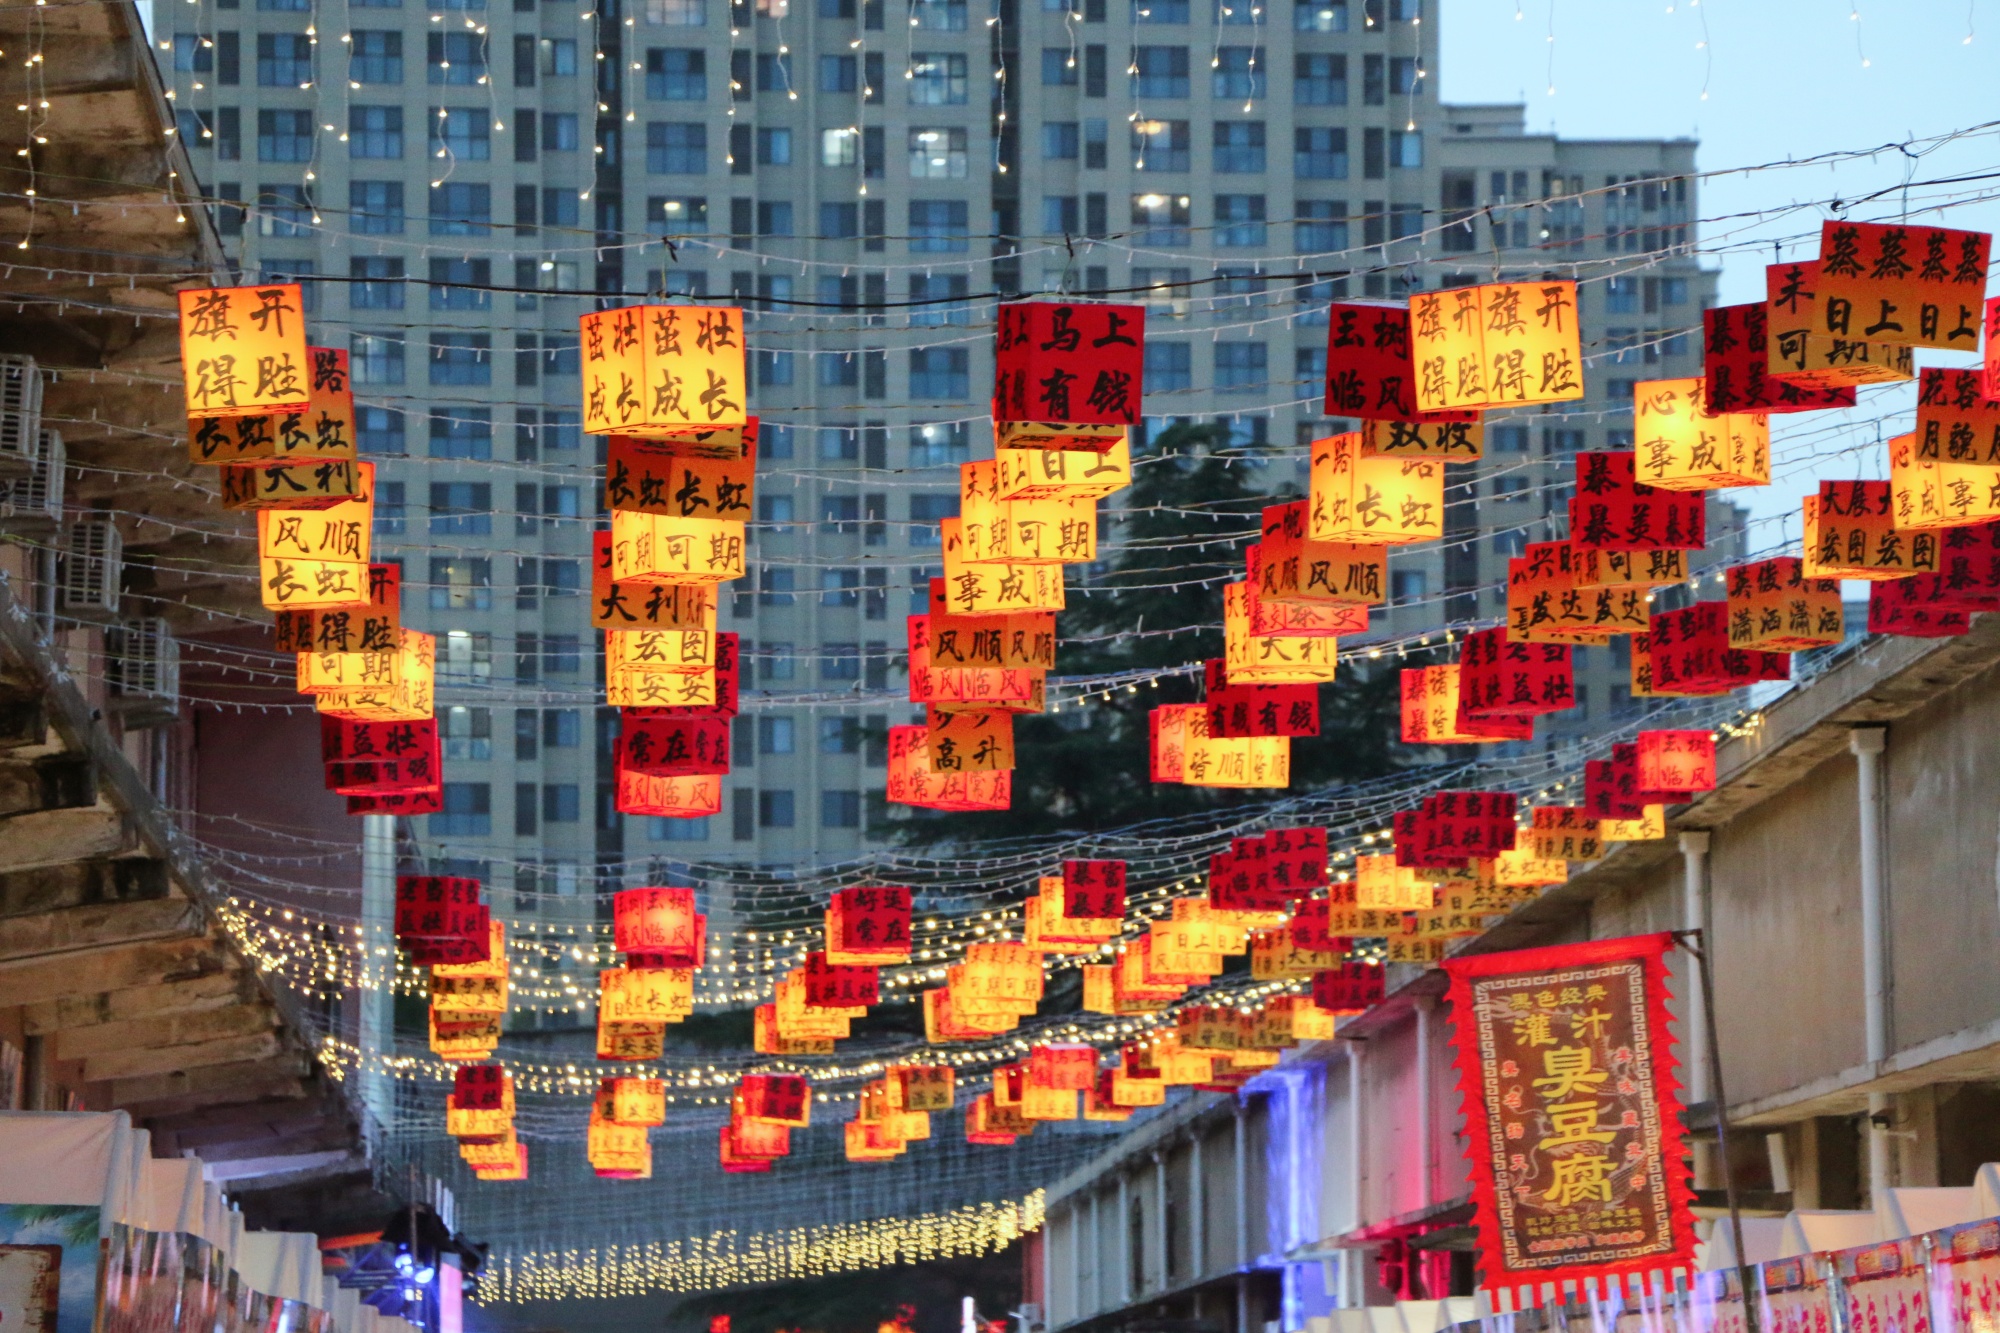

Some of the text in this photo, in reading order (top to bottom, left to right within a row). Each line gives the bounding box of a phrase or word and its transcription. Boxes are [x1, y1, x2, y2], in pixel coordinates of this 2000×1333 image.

[1822, 226, 1913, 280] 蒸蒸
[1919, 232, 1985, 285] 蒸蒸
[188, 289, 295, 342] 旗开
[1040, 307, 1137, 352] 马上
[1417, 290, 1477, 342] 旗开
[1487, 286, 1571, 338] 旗开
[1826, 296, 1904, 337] 日上
[1919, 303, 1976, 341] 日上
[587, 310, 640, 362] 茁壮
[653, 309, 737, 356] 茁壮
[1333, 310, 1410, 360] 玉树
[193, 352, 306, 407] 得胜
[1330, 369, 1410, 417] 临风
[1421, 352, 1487, 406] 得胜
[1491, 348, 1579, 400] 得胜
[1919, 371, 1982, 411] 花容
[588, 372, 641, 426] 成长
[651, 368, 741, 421] 成长
[1039, 368, 1134, 423] 有钱
[196, 417, 273, 458] 长虹
[279, 411, 348, 450] 长虹
[1920, 419, 1977, 460] 月貌
[1042, 450, 1122, 481] 日上
[1314, 437, 1352, 476] 一路
[1643, 431, 1722, 478] 事成
[1731, 432, 1768, 480] 事成
[608, 459, 667, 508] 长虹
[675, 470, 751, 517] 长虹
[1823, 481, 1871, 518] 大展
[1896, 479, 1939, 525] 事成
[1312, 492, 1352, 534] 长虹
[1356, 484, 1438, 530] 长虹
[1581, 504, 1660, 546] 暴美
[274, 517, 362, 559] 风顺
[664, 532, 742, 573] 可期
[966, 519, 1008, 558] 可期
[1017, 518, 1090, 558] 可期
[1819, 527, 1866, 565] 宏图
[1875, 529, 1935, 571] 宏图
[268, 560, 356, 602] 长虹
[1261, 556, 1300, 596] 风顺
[1307, 561, 1381, 599] 风顺
[1606, 550, 1682, 581] 可期
[1731, 562, 1782, 599] 英俊
[599, 584, 678, 624] 大利
[953, 566, 1030, 611] 事成
[1595, 588, 1646, 626] 发达
[1529, 591, 1588, 627] 发达
[1732, 608, 1782, 642] 潇洒
[1789, 600, 1840, 636] 潇洒
[318, 612, 399, 651] 得胜
[632, 630, 706, 663] 宏图
[936, 630, 1004, 663] 风顺
[1010, 630, 1053, 667] 风顺
[1260, 637, 1329, 664] 大利
[914, 667, 959, 699] 临风
[963, 669, 1023, 698] 临风
[1507, 672, 1573, 705] 益壮
[1258, 701, 1317, 735] 有钱
[349, 725, 418, 758] 益壮
[629, 729, 691, 768] 常在
[936, 735, 1001, 771] 高升
[1662, 734, 1708, 759] 玉树
[1190, 752, 1246, 781] 皆顺
[1253, 752, 1287, 782] 皆顺
[1661, 766, 1710, 788] 临风
[653, 779, 714, 809] 临风
[1271, 831, 1319, 854] 马上
[1500, 859, 1540, 880] 长虹
[645, 891, 689, 915] 玉树
[854, 889, 908, 912] 好运
[645, 923, 689, 946] 临风
[856, 919, 906, 945] 常在
[1178, 934, 1210, 949] 日上
[1218, 934, 1243, 950] 日上
[646, 989, 691, 1011] 长虹
[1507, 984, 1609, 1012] 黑色经典
[1512, 1008, 1613, 1048] 灌汁
[1531, 1045, 1620, 1208] 臭豆腐
